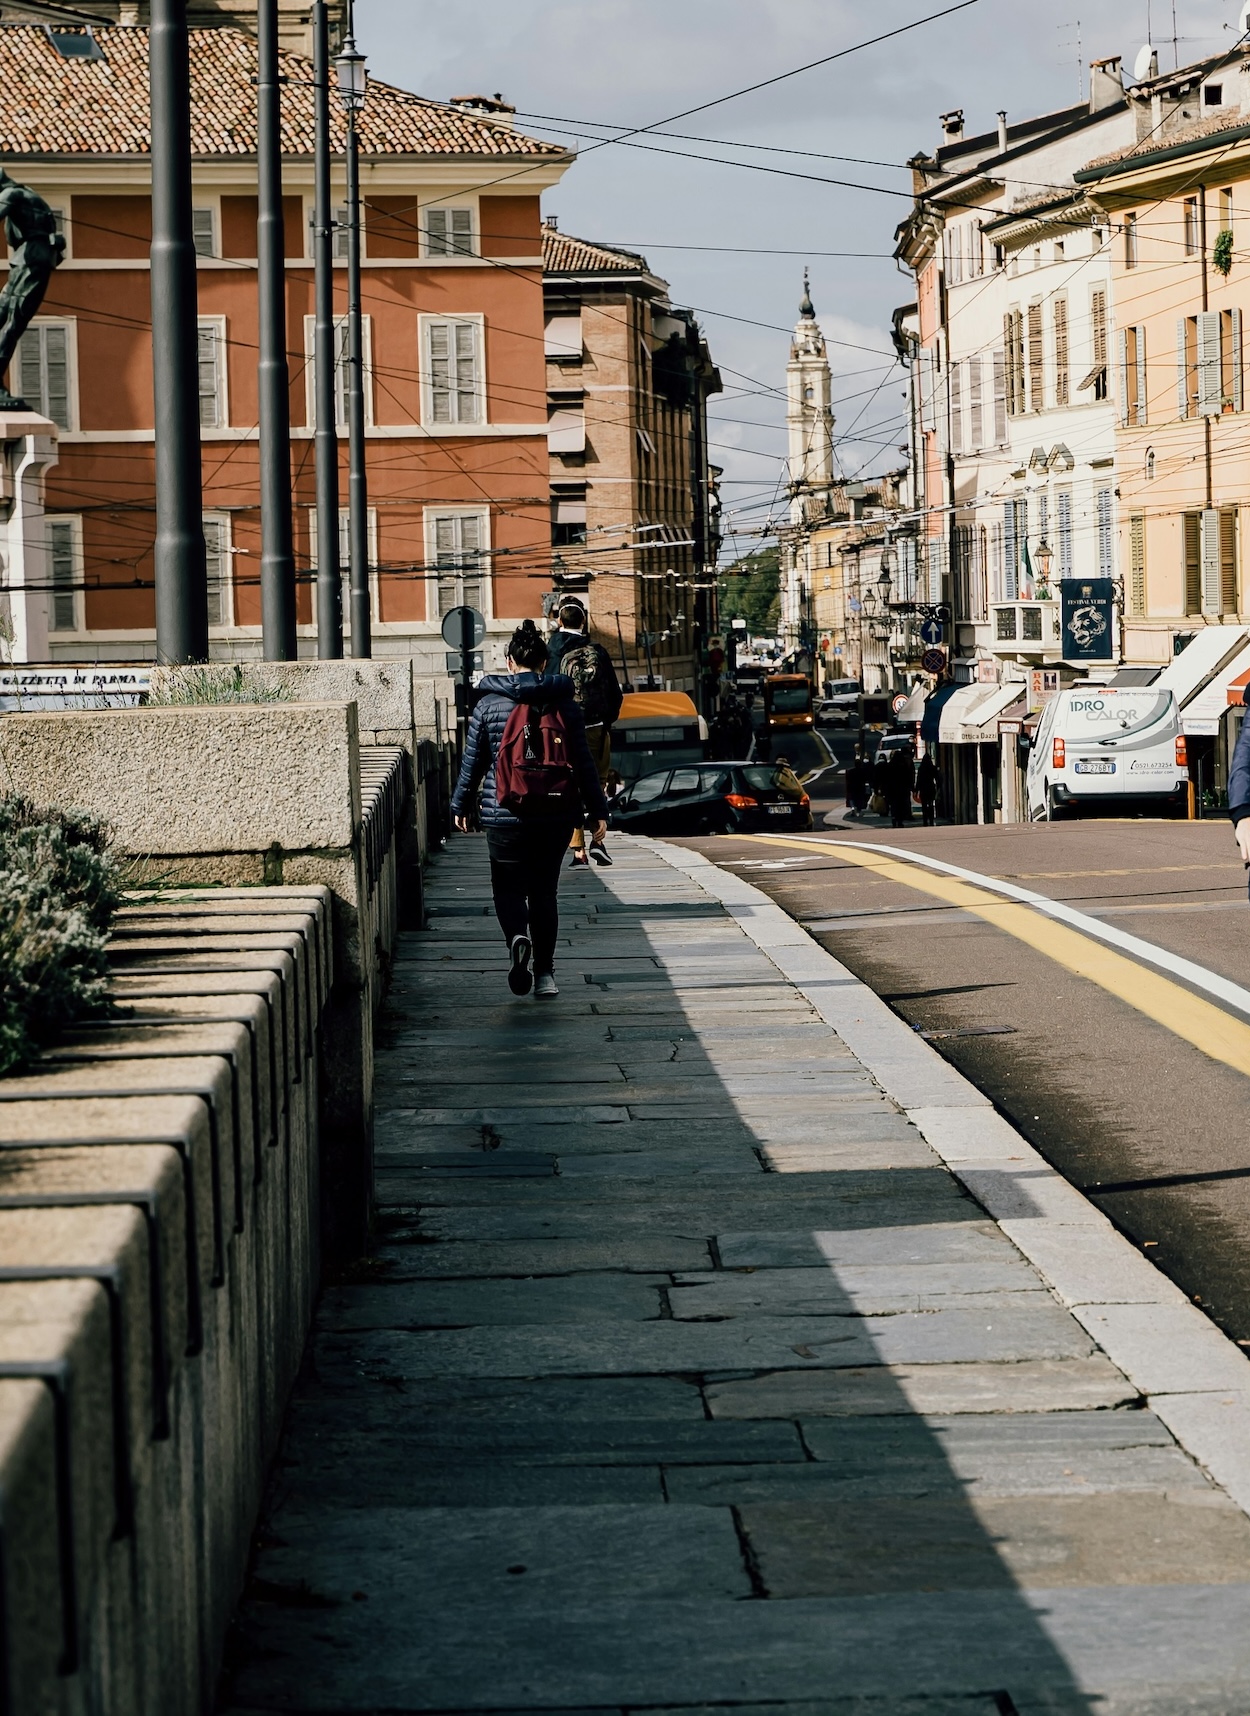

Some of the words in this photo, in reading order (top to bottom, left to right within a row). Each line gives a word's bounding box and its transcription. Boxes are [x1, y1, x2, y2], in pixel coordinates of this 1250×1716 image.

[2, 675, 68, 686] GAZZETTA
[73, 675, 87, 685] DI
[92, 675, 137, 685] PARMA
[1033, 672, 1042, 692] BAR
[1070, 700, 1105, 712] IDRO
[1085, 709, 1139, 721] CALOR
